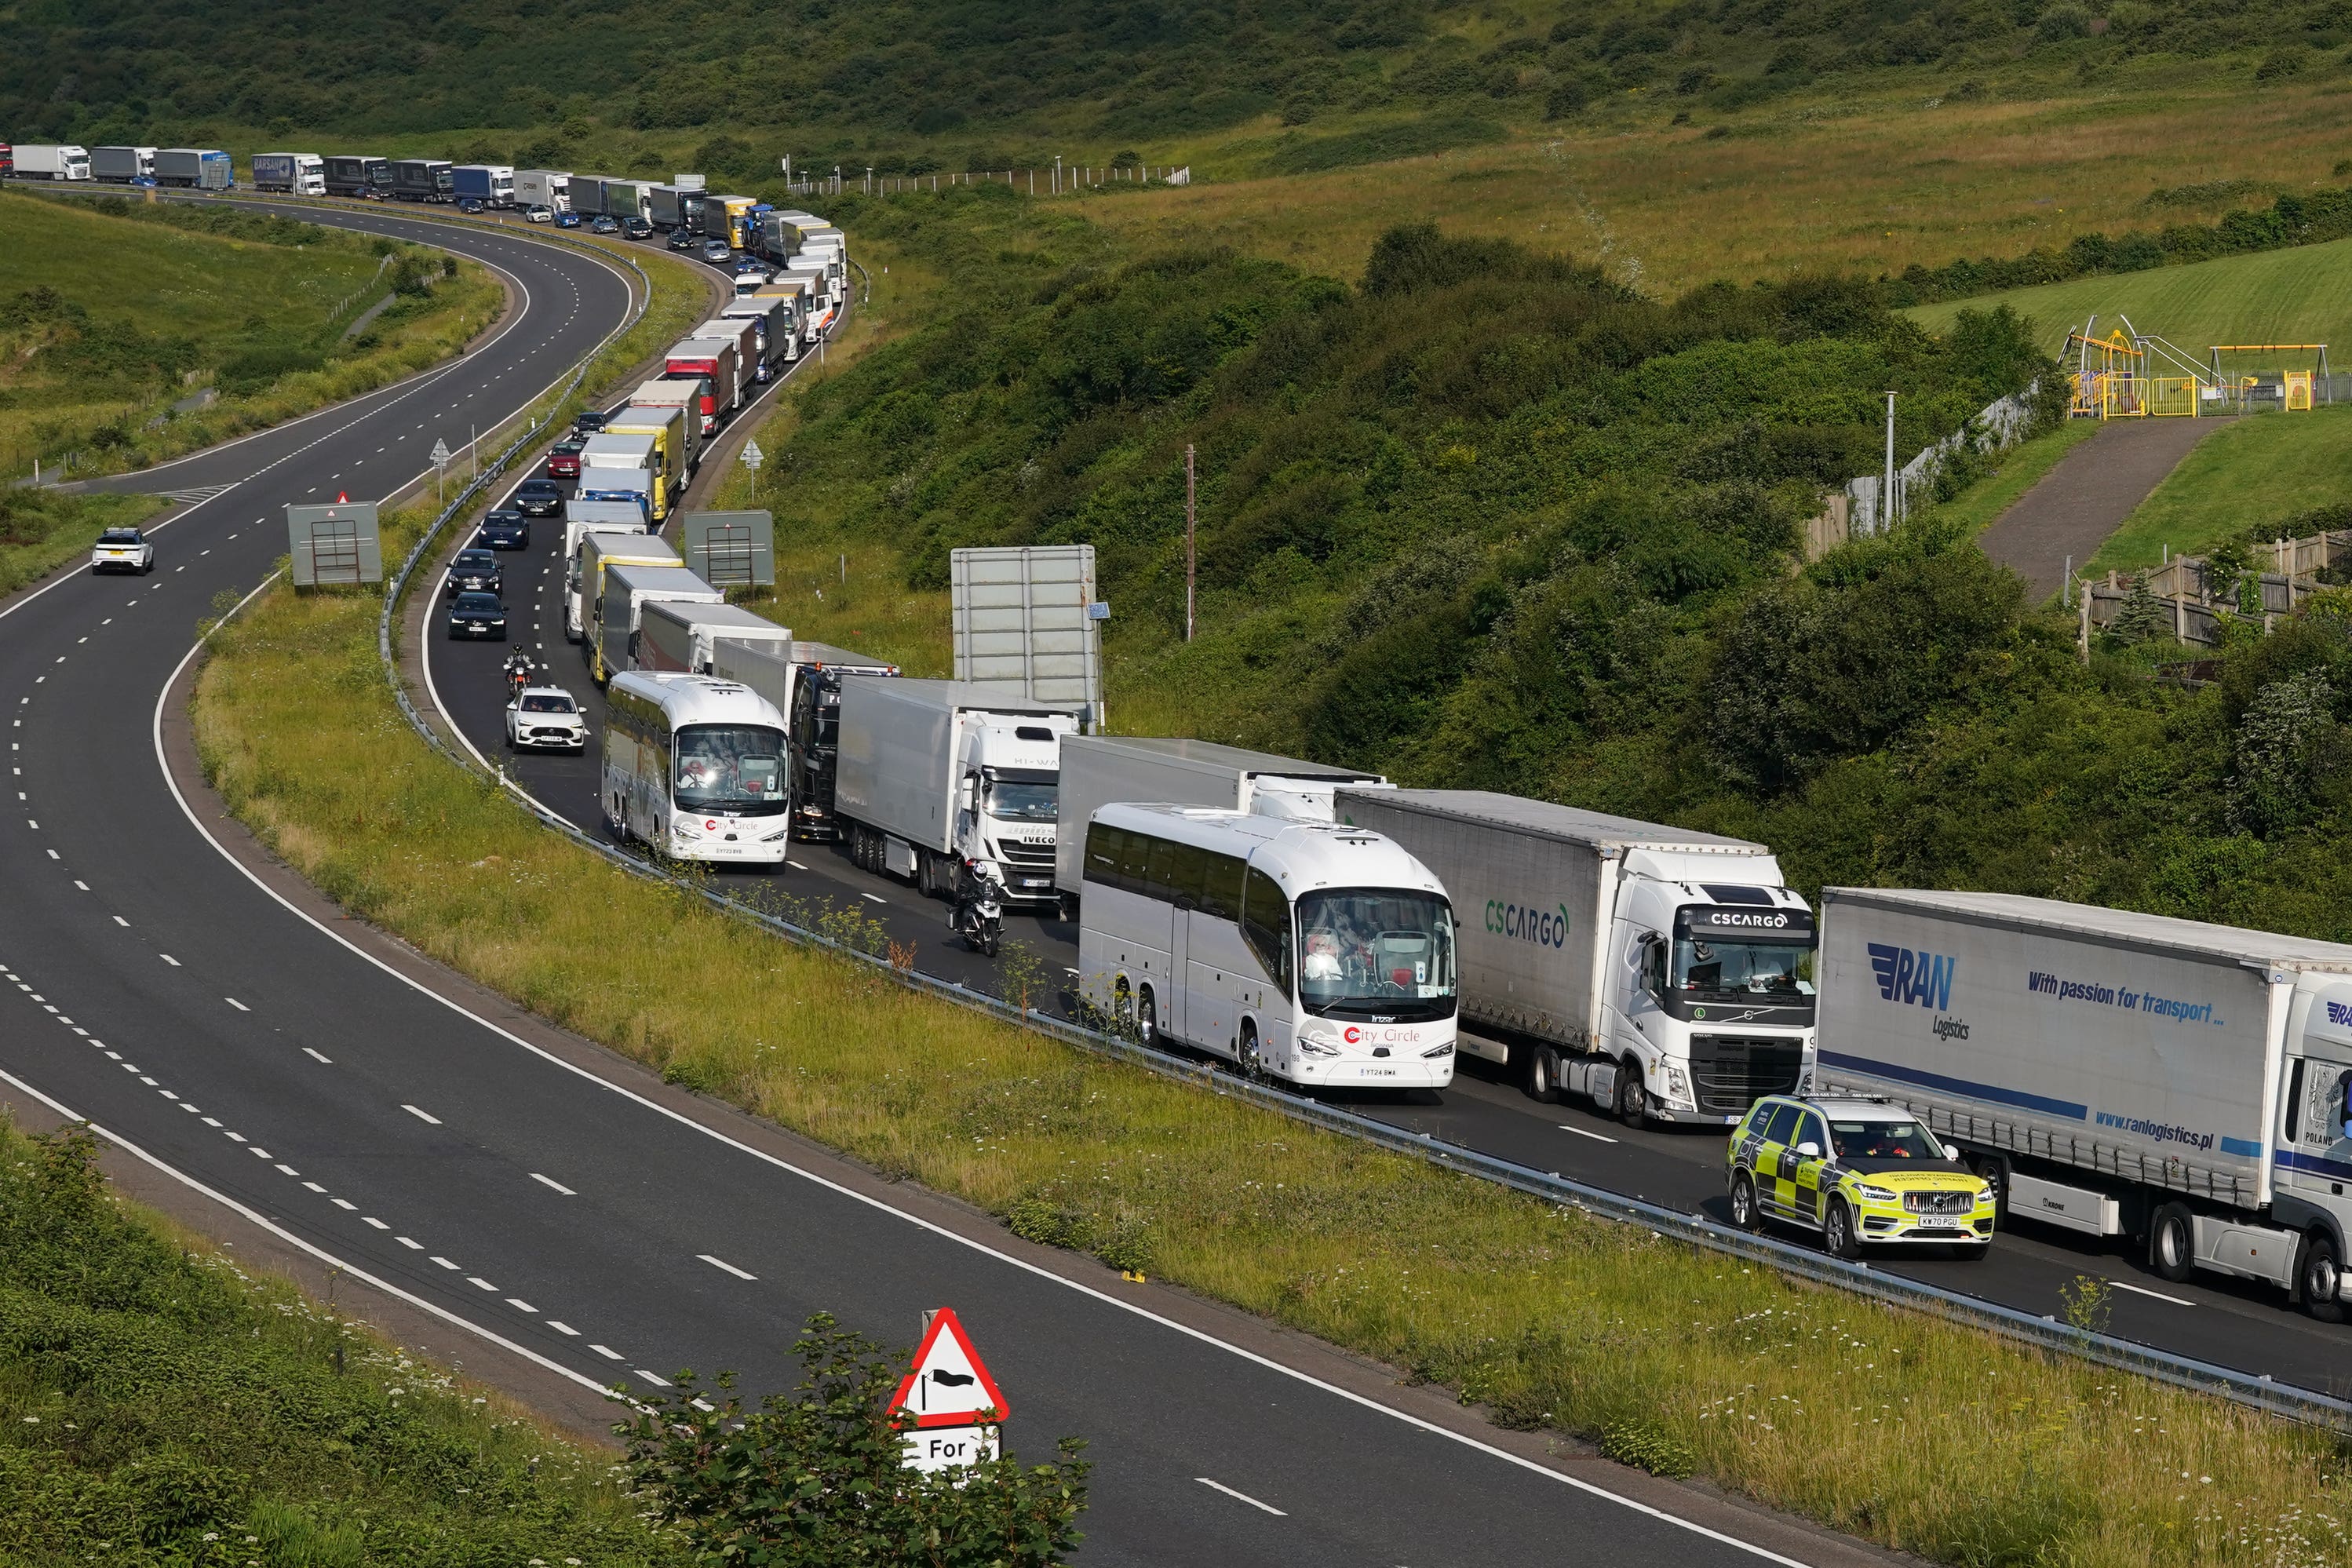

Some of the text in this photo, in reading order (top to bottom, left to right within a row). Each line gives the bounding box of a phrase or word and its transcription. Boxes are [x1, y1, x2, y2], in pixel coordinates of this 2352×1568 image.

[706, 819, 758, 830] City Circle
[1486, 899, 1569, 948] CSCARGO
[1711, 913, 1788, 928] CSCARGO
[1893, 947, 1955, 1012] RAN
[2029, 971, 2058, 994] With
[2059, 980, 2114, 1005] passion
[2117, 986, 2140, 1010] for
[1344, 1026, 1420, 1044] City Circle
[1932, 1015, 1970, 1041] Logistics
[2096, 1111, 2214, 1150] www.ranlogistics.pl
[2305, 1132, 2332, 1146] POLAND
[2048, 1202, 2065, 1211] KRONE
[930, 1439, 966, 1458] For
